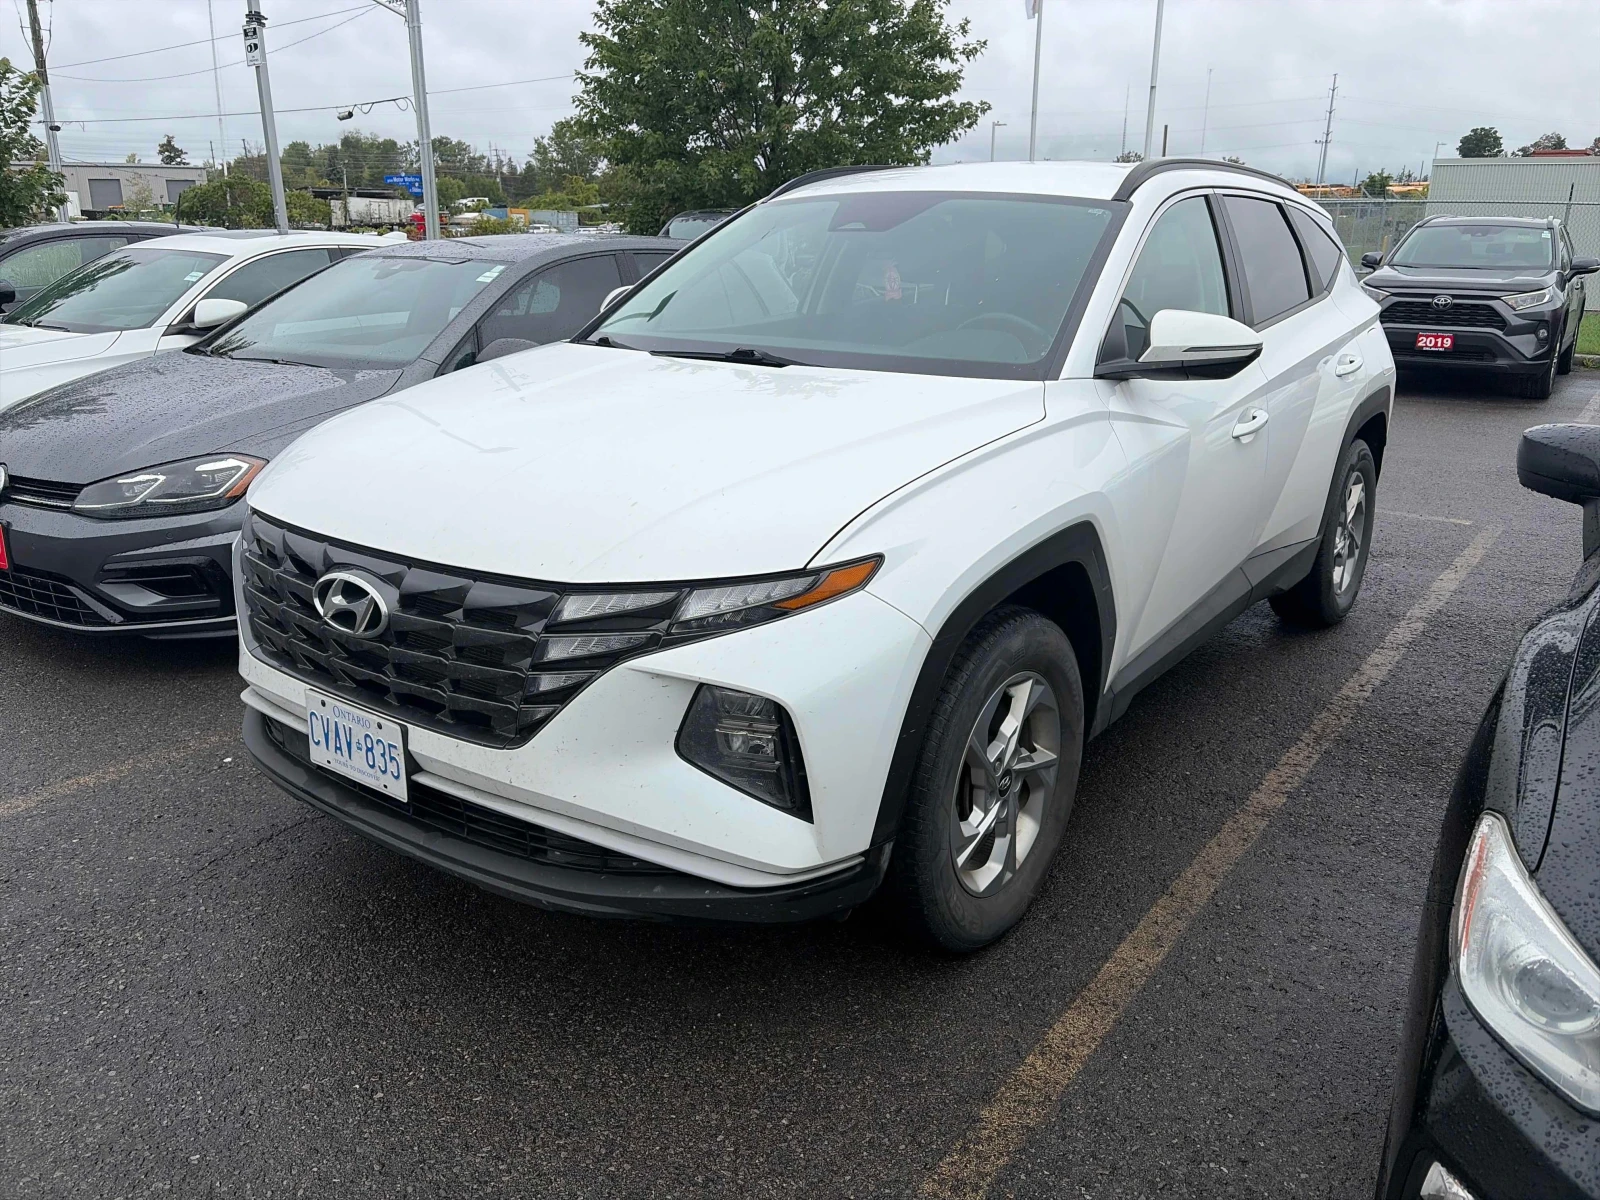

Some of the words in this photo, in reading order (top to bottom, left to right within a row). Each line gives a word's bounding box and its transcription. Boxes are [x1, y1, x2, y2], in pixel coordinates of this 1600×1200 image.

[1417, 336, 1452, 348] 2019
[332, 705, 371, 730] ONTARIO
[333, 758, 349, 769] YOURS
[349, 764, 357, 772] TO
[356, 767, 381, 781] DISCOVER
